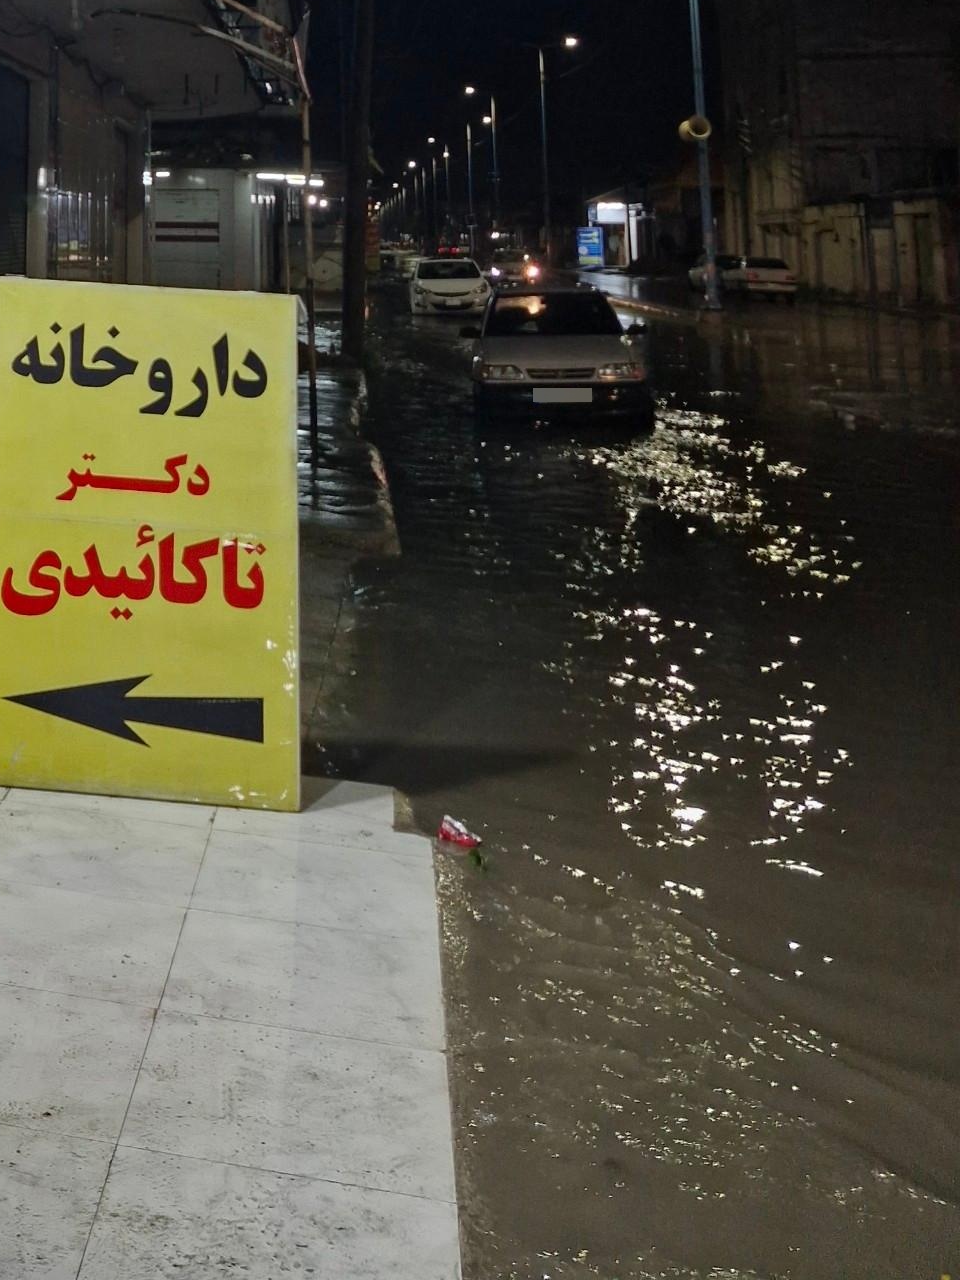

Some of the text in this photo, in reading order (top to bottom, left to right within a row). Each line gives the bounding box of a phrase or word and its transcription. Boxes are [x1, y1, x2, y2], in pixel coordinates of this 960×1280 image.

[11, 322, 269, 418] داروخانه
[55, 452, 211, 501] دکتر
[1, 523, 267, 620] تاکائیدی
